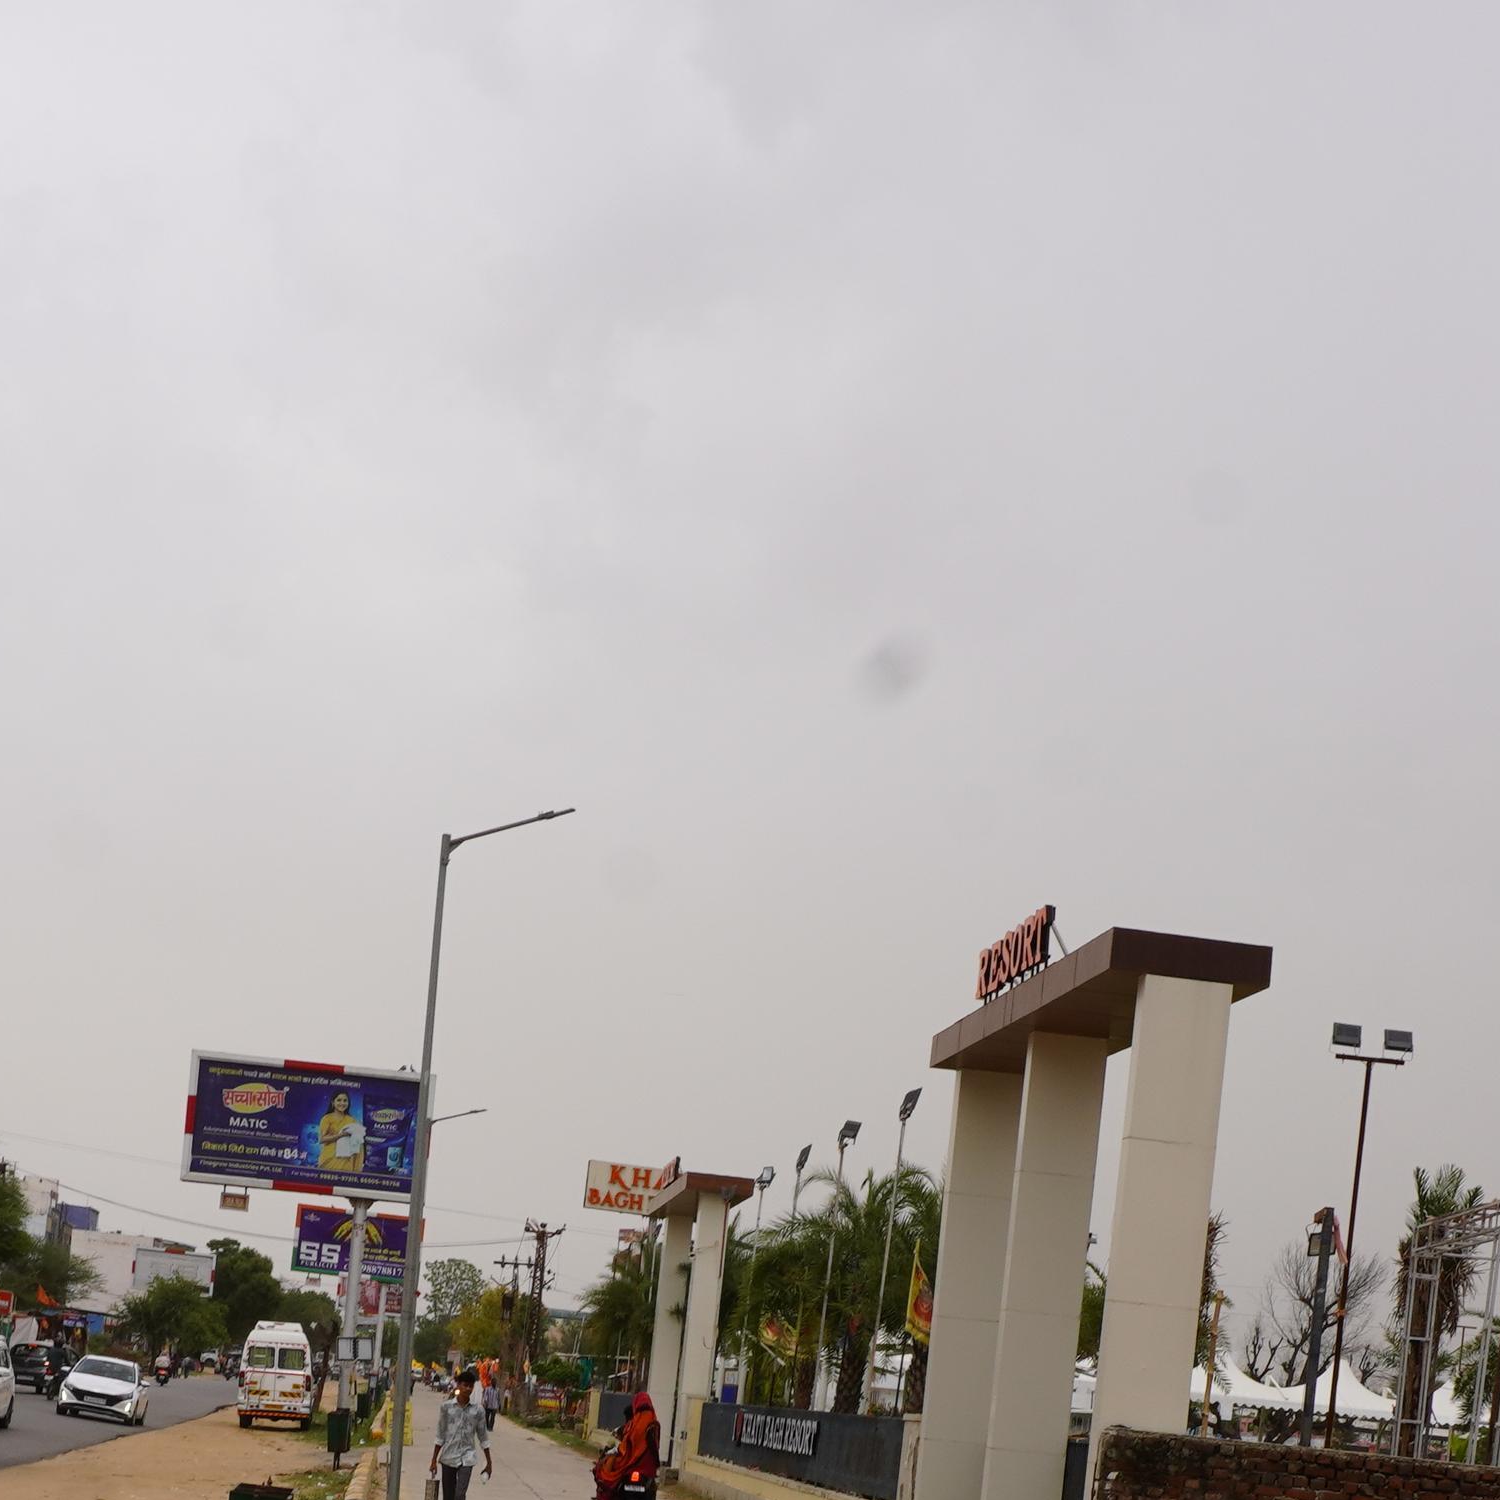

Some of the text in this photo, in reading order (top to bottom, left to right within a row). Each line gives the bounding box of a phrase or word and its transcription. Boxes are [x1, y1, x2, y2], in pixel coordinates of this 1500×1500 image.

[976, 906, 1048, 999] RESORT
[228, 1116, 268, 1130] MATIC
[587, 1187, 644, 1212] BAGH
[741, 1412, 766, 1447] KHATU
[763, 1415, 786, 1451] BAGH
[783, 1417, 818, 1457] RESORT
